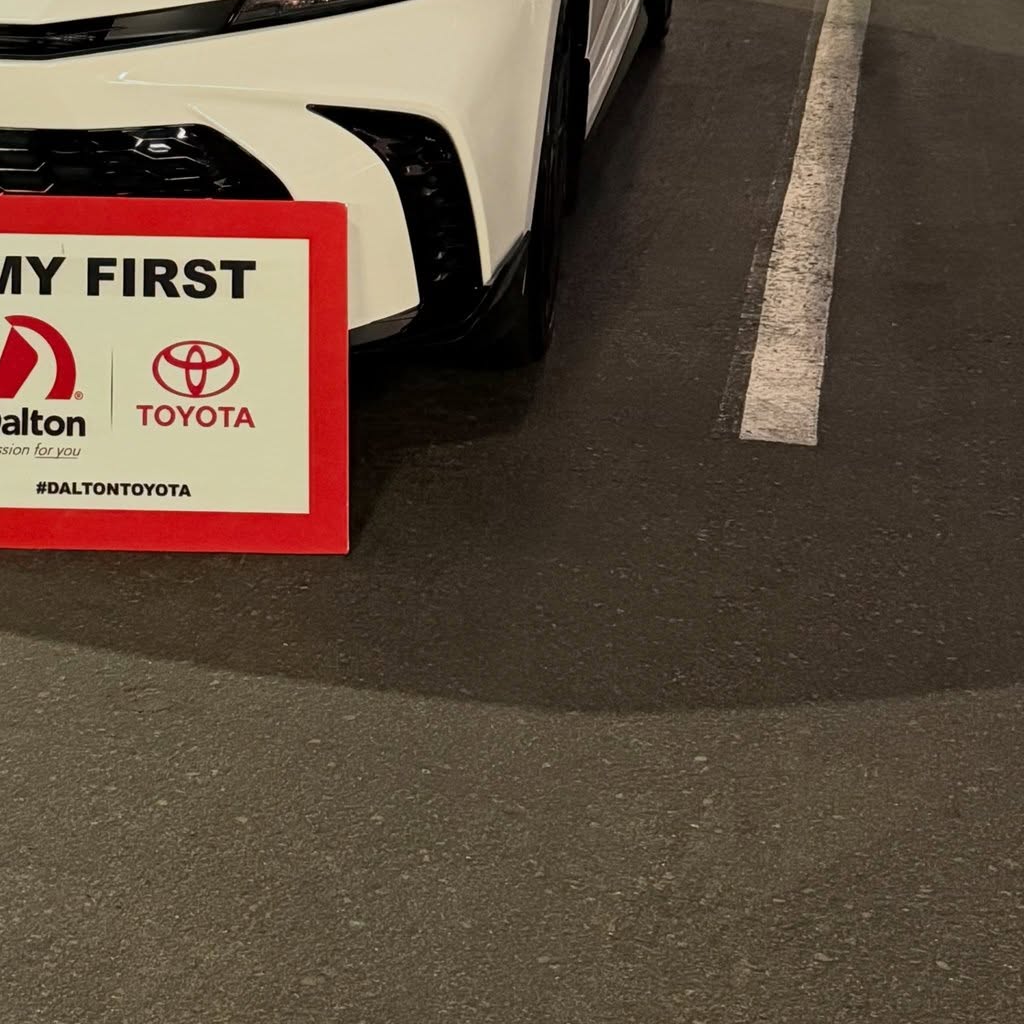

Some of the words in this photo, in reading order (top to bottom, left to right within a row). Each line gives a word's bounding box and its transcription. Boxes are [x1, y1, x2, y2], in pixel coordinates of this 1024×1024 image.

[86, 258, 257, 299] FIRST
[136, 404, 256, 429] TOYOTA
[33, 442, 54, 458] for
[54, 446, 82, 459] you
[35, 481, 191, 498] #DALTONTOYOTA
